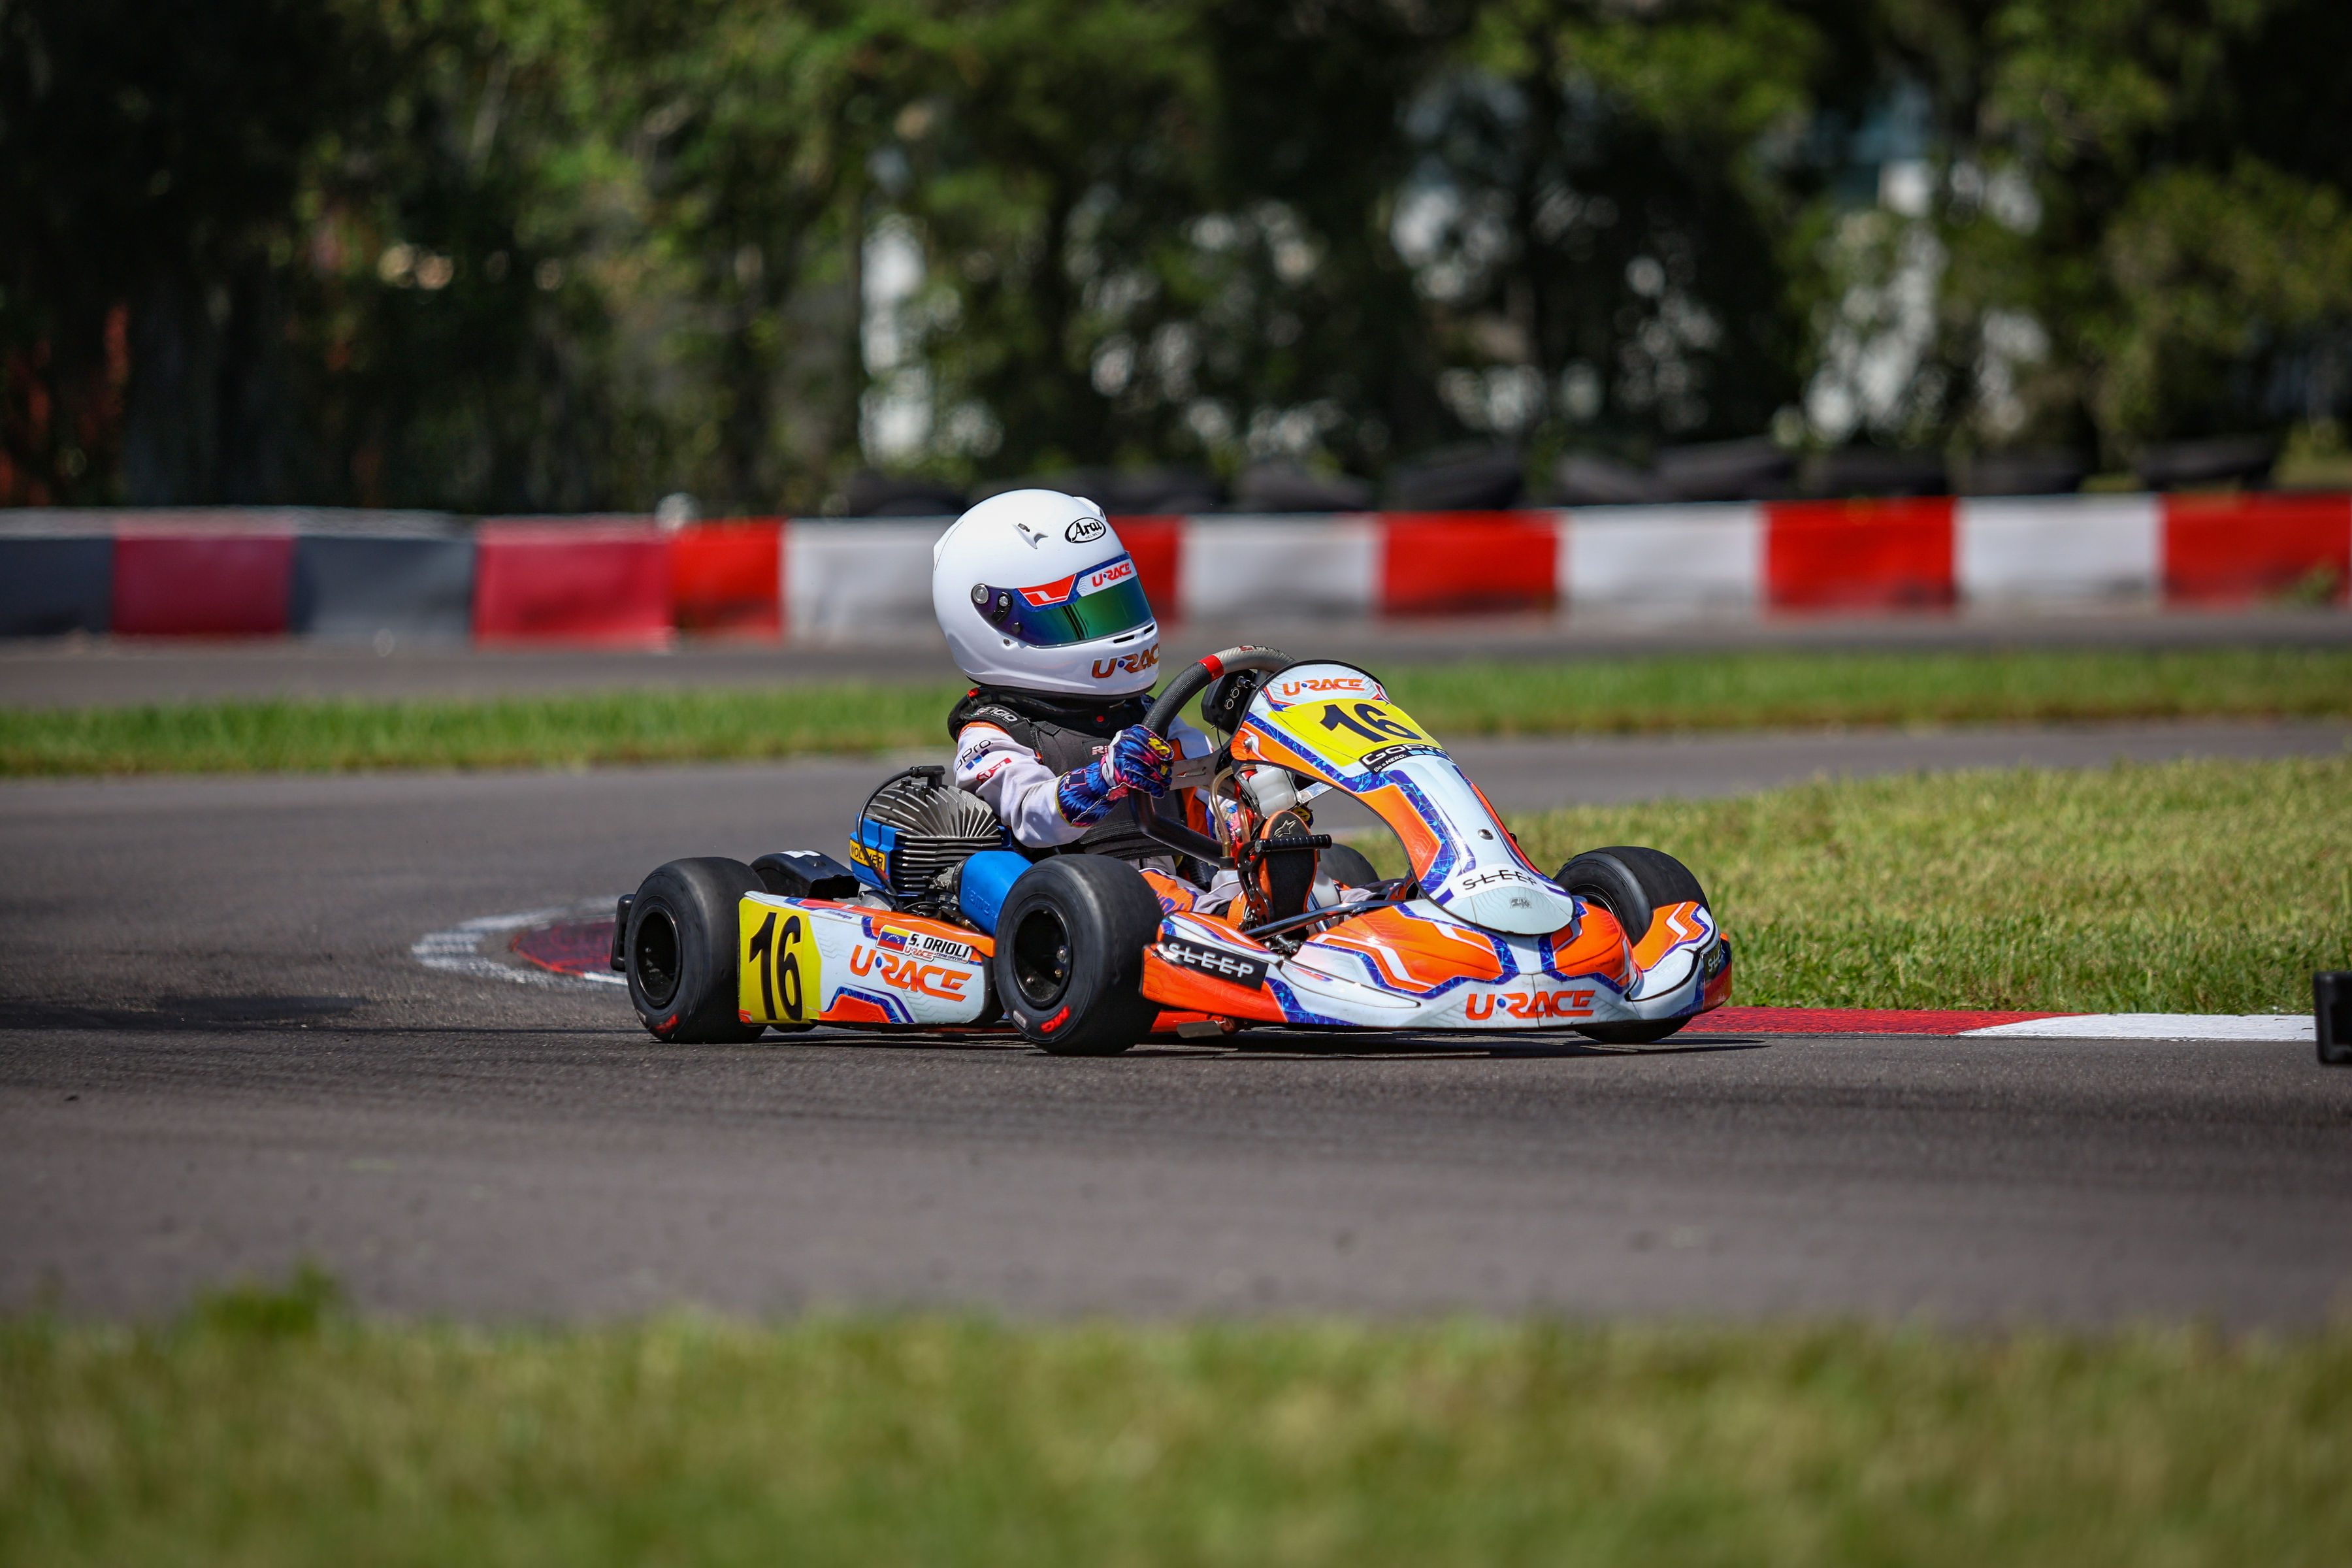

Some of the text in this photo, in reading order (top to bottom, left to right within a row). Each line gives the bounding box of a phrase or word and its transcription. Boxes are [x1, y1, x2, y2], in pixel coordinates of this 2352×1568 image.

[1071, 521, 1102, 542] Arai
[1320, 703, 1423, 743] 16
[1462, 870, 1537, 890] SLEEP
[909, 934, 970, 958] S. ORIOLI
[1168, 942, 1255, 978] SLEEP
[749, 911, 803, 1022] 16
